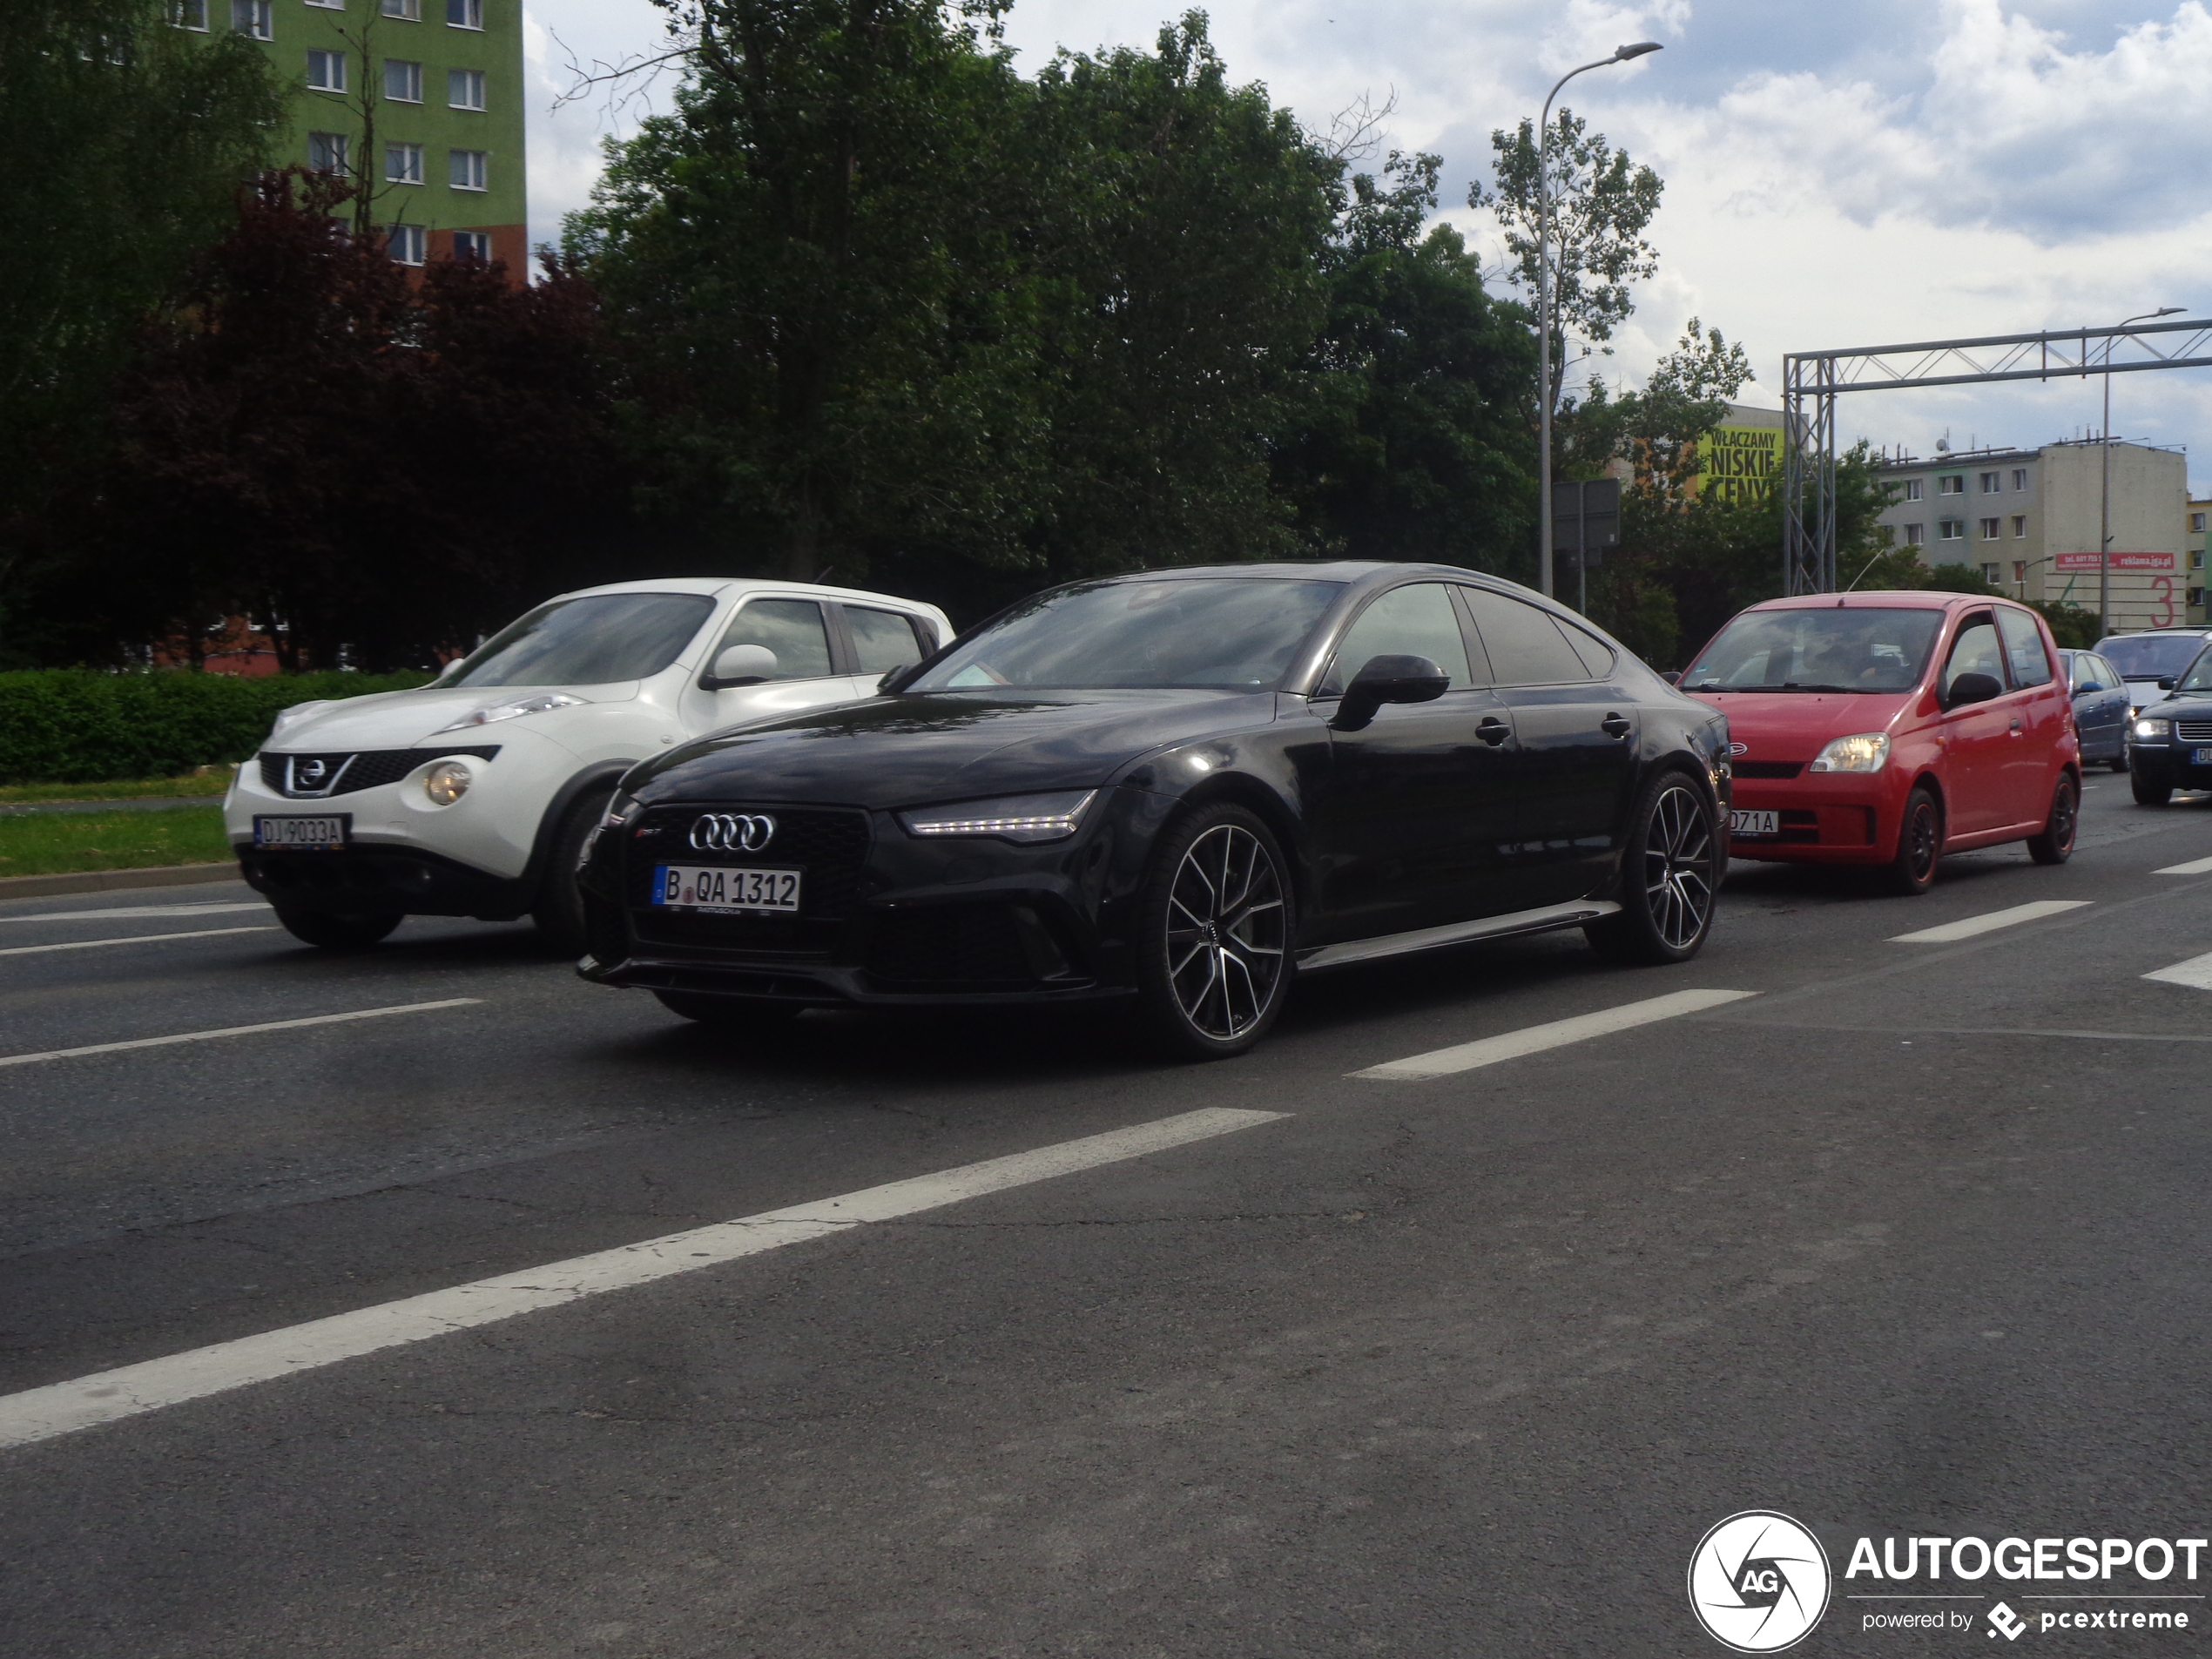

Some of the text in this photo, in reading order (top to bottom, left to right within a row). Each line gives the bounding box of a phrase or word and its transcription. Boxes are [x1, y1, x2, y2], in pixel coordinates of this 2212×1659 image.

[1711, 447, 1775, 476] NISKIE
[2150, 575, 2175, 628] 3
[264, 820, 340, 842] DJ 9033A
[666, 870, 681, 900] B
